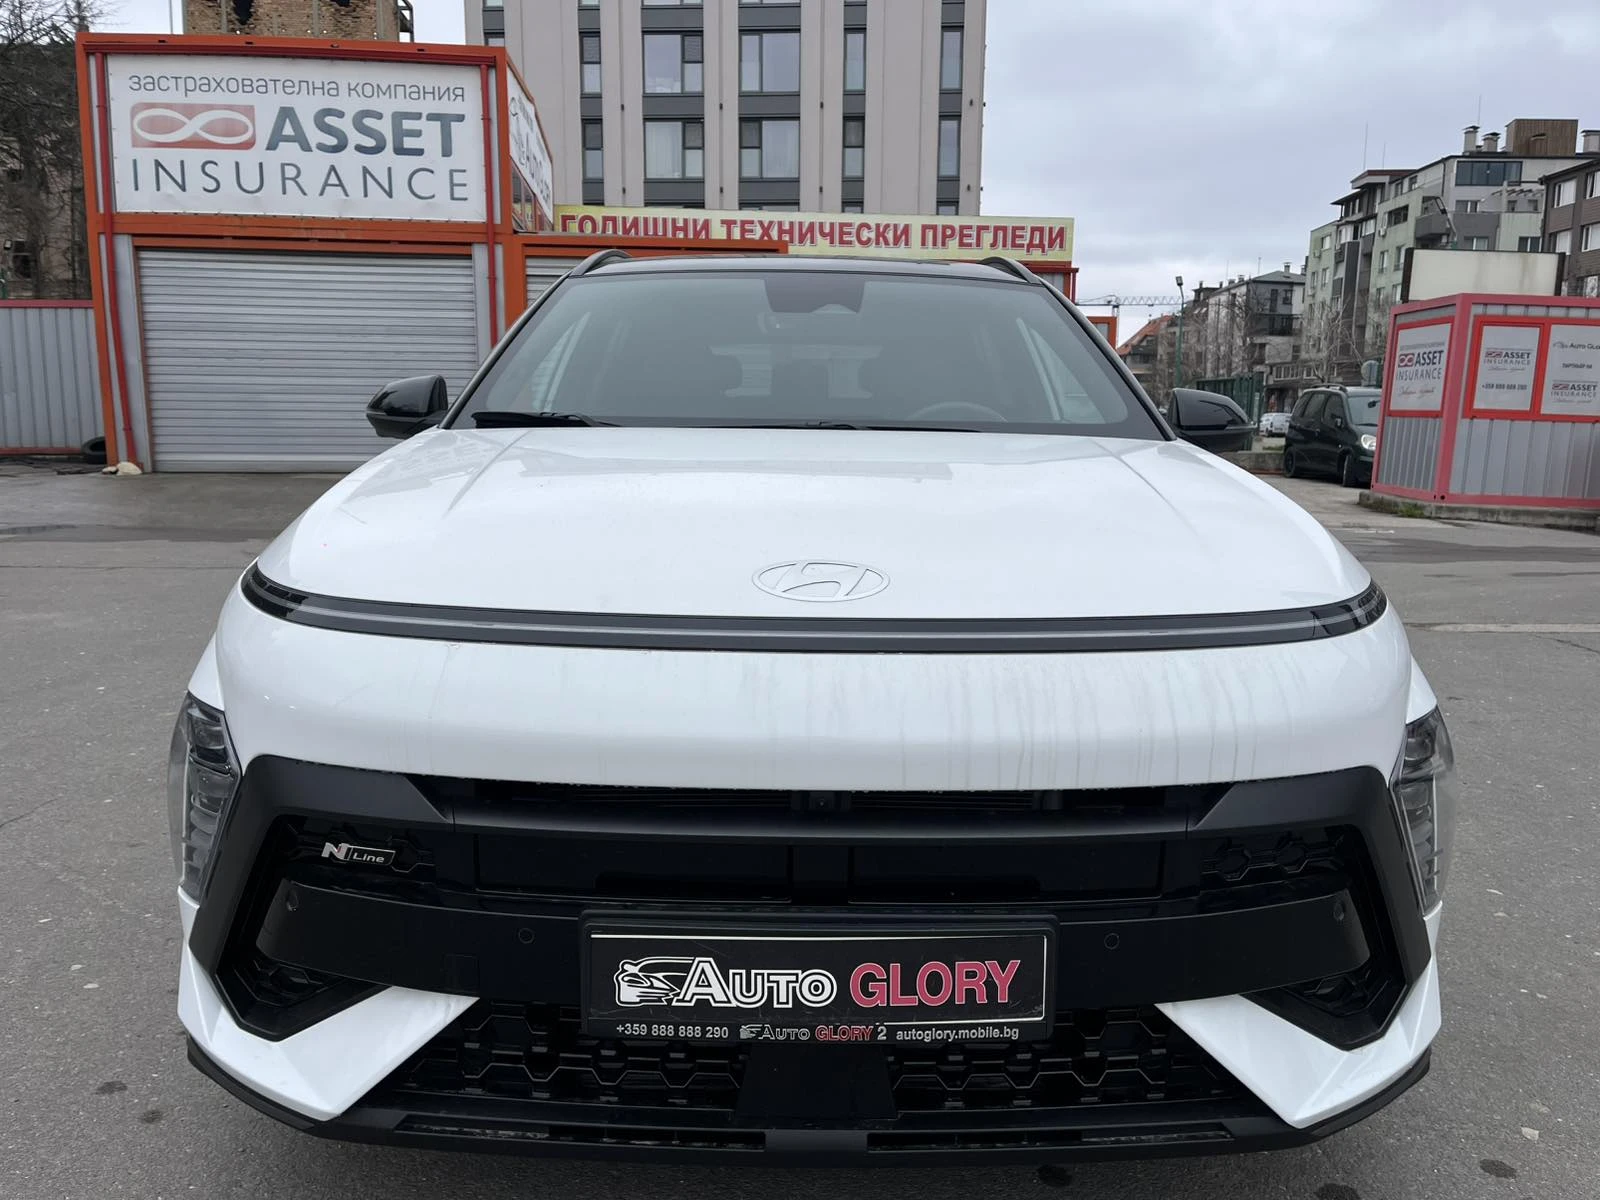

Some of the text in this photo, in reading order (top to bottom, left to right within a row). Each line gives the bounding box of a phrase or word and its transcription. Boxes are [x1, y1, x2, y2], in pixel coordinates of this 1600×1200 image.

[129, 74, 465, 102] застрахователна компания
[265, 106, 466, 157] ASSET
[132, 158, 468, 201] INSURANCE
[720, 218, 911, 247] ТЕХНИЧЕСКИ
[920, 223, 1065, 255] ПРЕГЛЕДИ
[1415, 350, 1444, 367] ASSET
[1484, 358, 1530, 366] INSURANCE
[1503, 351, 1531, 359] ASSET
[1397, 368, 1442, 381] INSURANCE
[1570, 383, 1597, 391] ASSET
[321, 842, 385, 863] N Line
[850, 960, 1021, 1007] GLORY
[616, 1023, 647, 1036] +359
[651, 1025, 675, 1036] 888
[678, 1025, 702, 1037] 888
[705, 1026, 729, 1039] 290
[815, 1025, 873, 1041] GLORY
[877, 1026, 887, 1040] 2
[896, 1026, 1019, 1042] autoglory.mobile.bg
